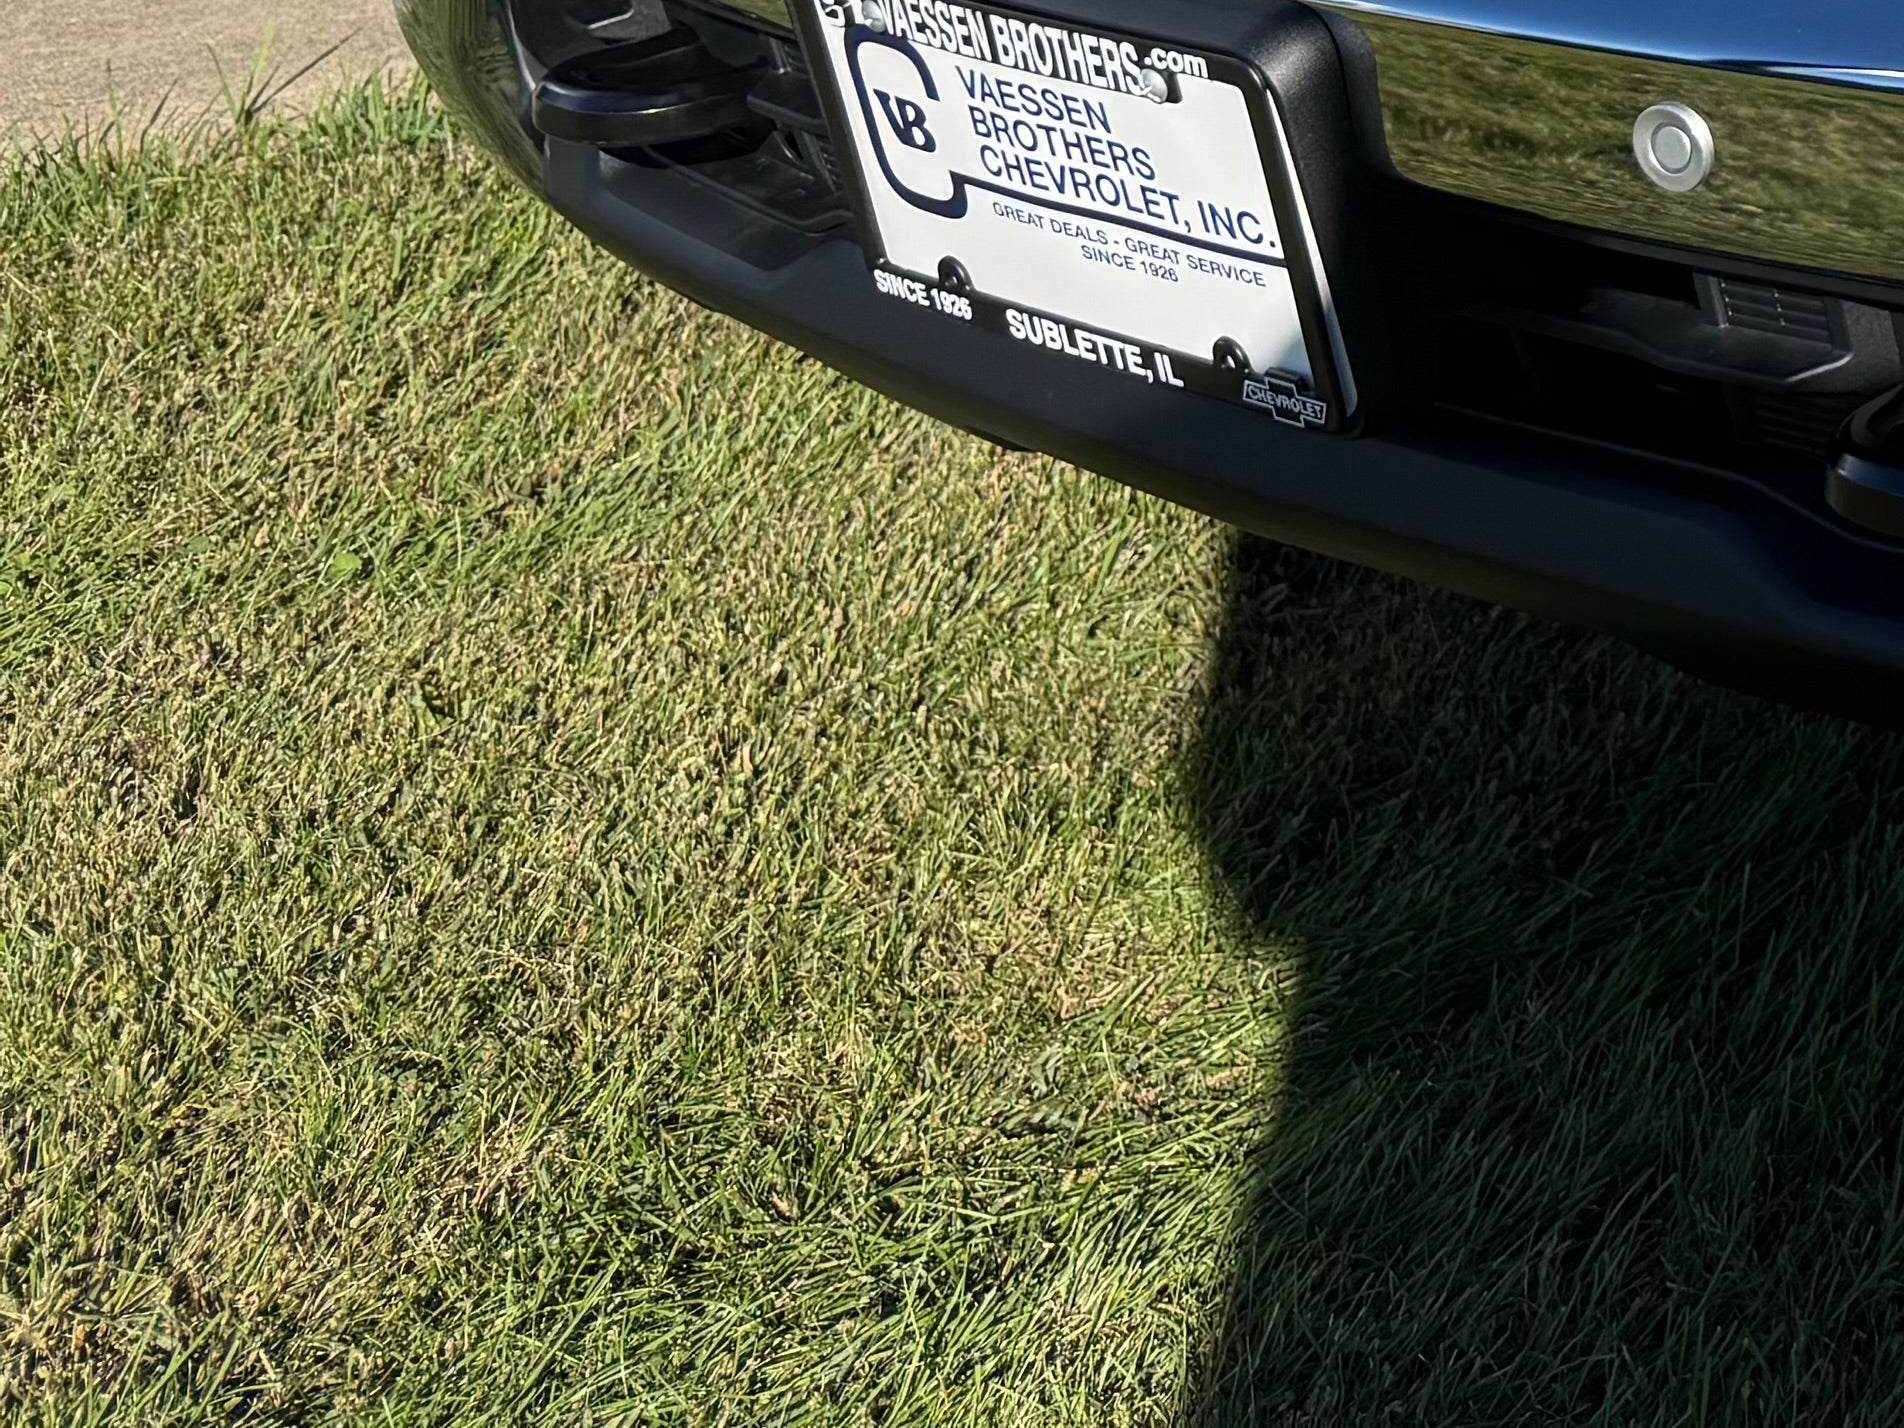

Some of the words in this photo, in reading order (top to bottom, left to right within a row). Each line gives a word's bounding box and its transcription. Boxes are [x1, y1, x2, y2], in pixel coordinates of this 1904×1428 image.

[955, 65, 1111, 134] VAESSEN
[968, 104, 1156, 181] BROTHERS
[979, 144, 1192, 233] CHEVROLET,
[1196, 200, 1276, 248] INC.
[992, 202, 1044, 230] GREAT
[1049, 218, 1109, 246] DEALS
[1124, 236, 1181, 265] GREAT
[1186, 254, 1267, 287] SERVICE
[1081, 245, 1136, 271] SINCE
[1139, 260, 1179, 283] 1926
[873, 269, 930, 307] SINCE
[930, 288, 973, 321] 1926
[1005, 308, 1154, 383] SUBLETTE,
[1154, 352, 1185, 387] IL
[1248, 385, 1322, 418] CHEVROLET
